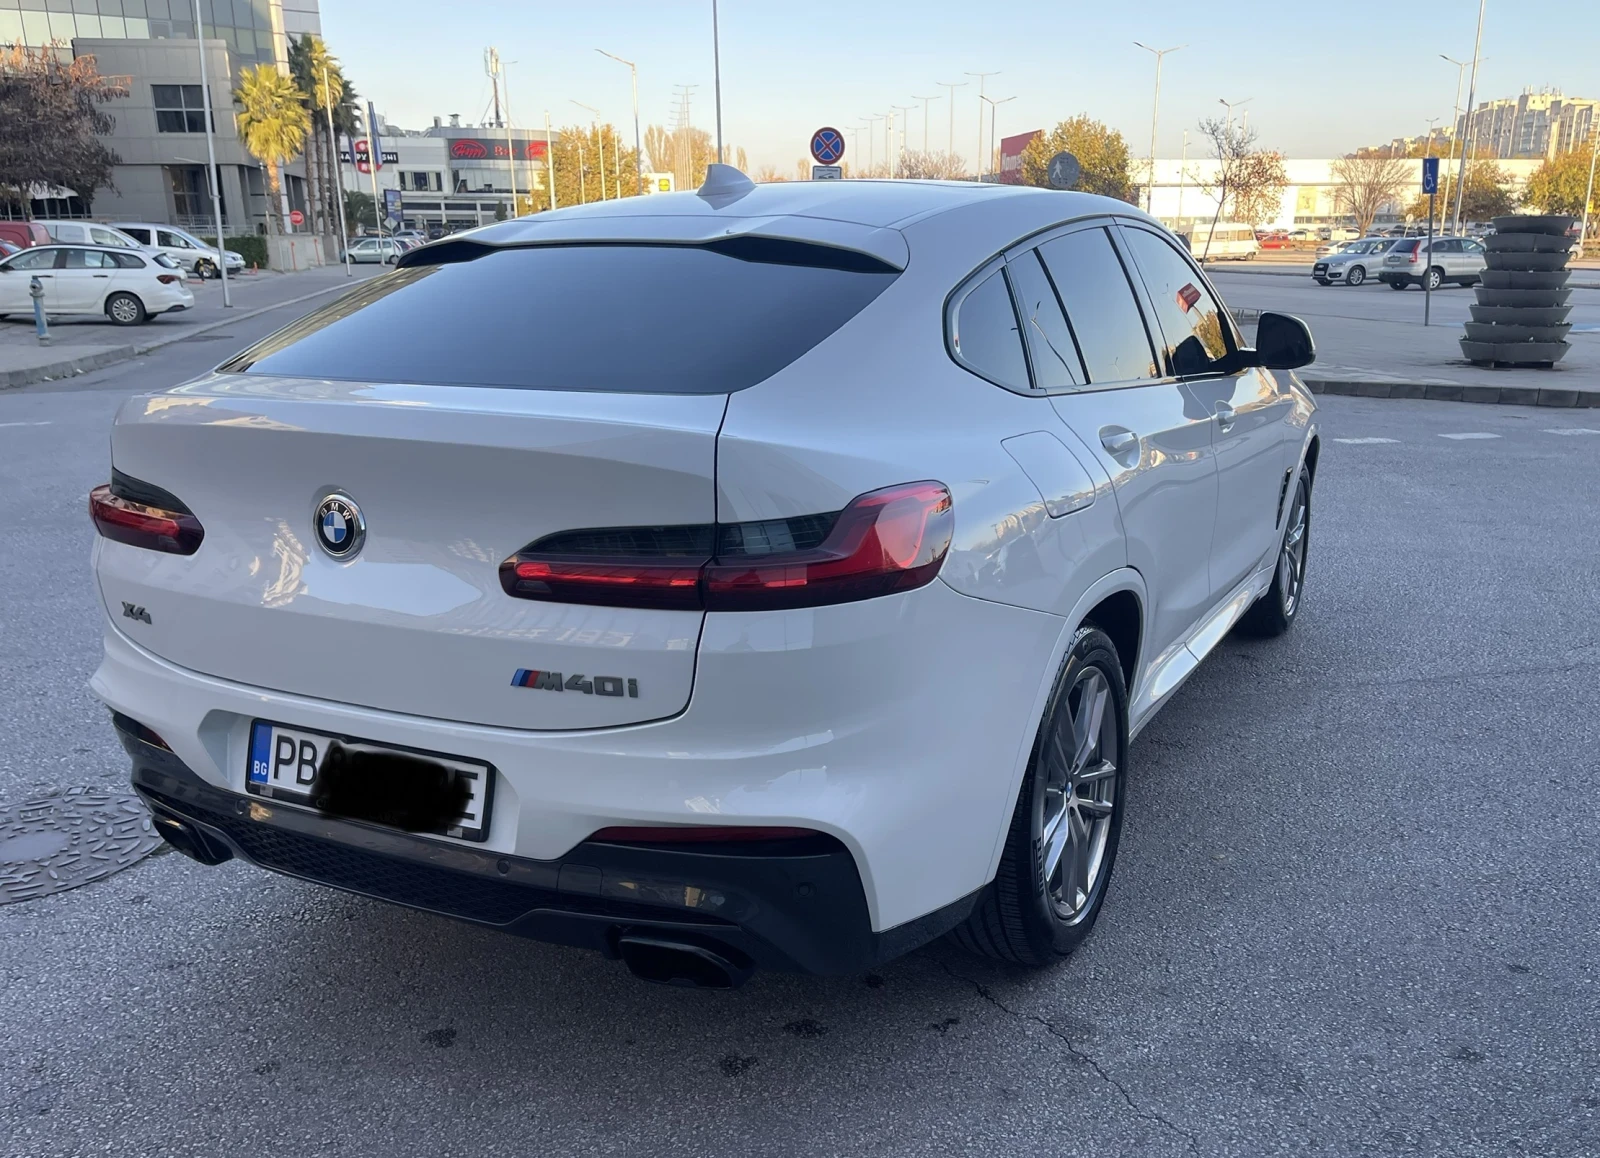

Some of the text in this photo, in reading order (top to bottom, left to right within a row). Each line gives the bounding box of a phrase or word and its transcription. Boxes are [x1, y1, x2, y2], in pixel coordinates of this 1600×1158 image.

[454, 144, 483, 158] Happy
[321, 502, 352, 520] BMW
[121, 601, 152, 625] X4
[534, 671, 639, 698] M40i
[253, 760, 268, 776] BG
